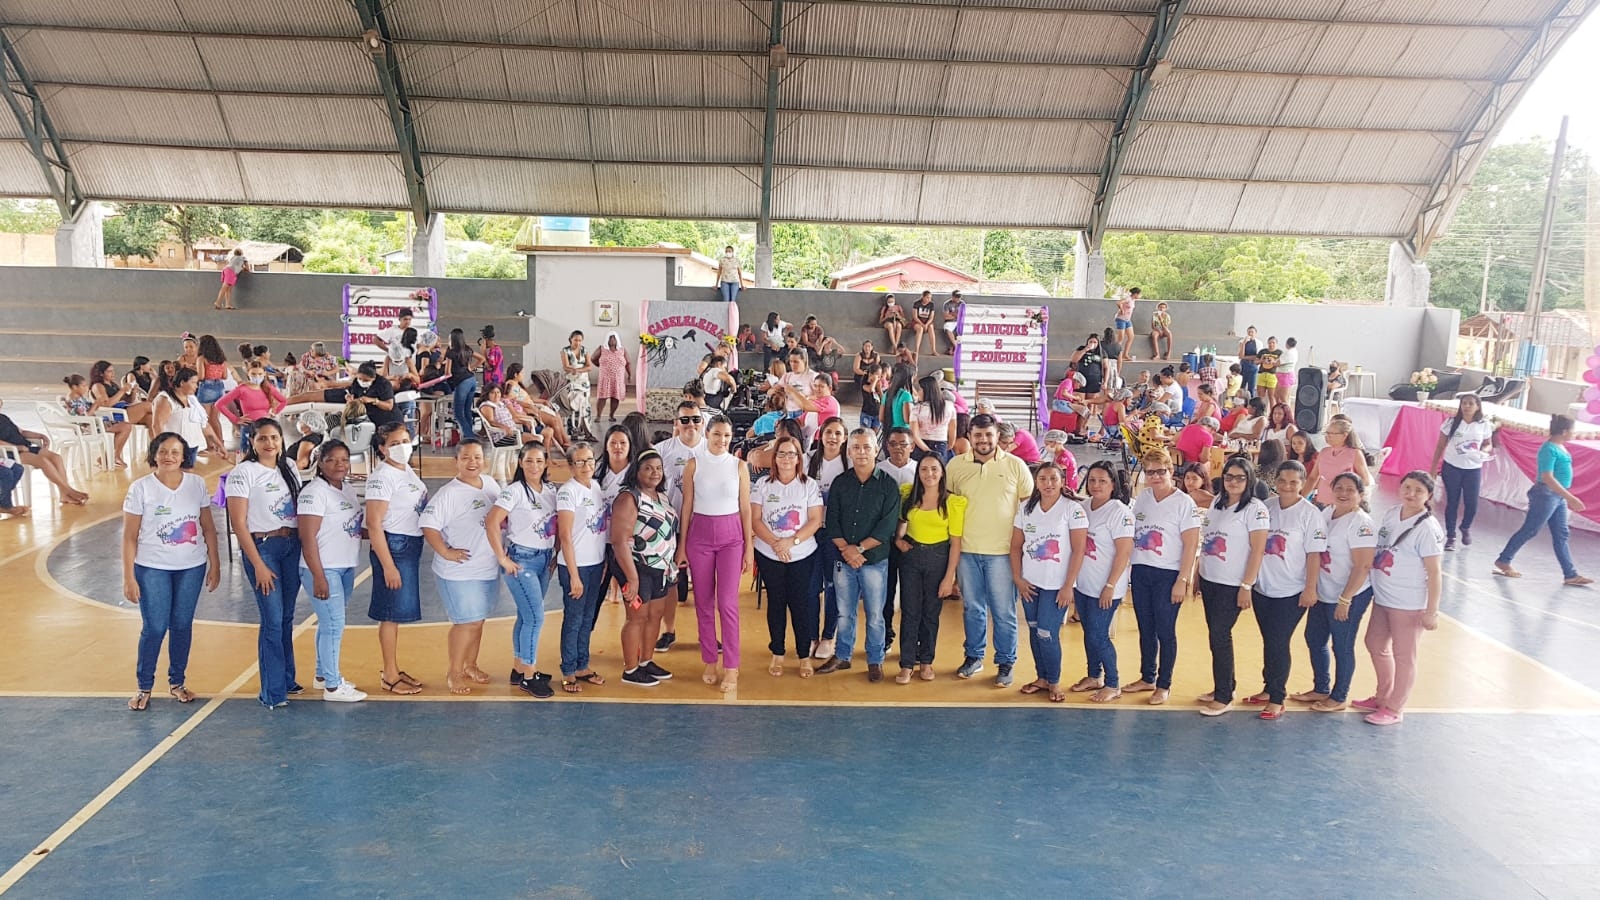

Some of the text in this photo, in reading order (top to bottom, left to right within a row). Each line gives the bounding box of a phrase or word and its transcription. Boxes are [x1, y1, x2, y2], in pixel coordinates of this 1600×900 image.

[972, 323, 1029, 336] MANICURE
[995, 339, 1003, 350] E
[971, 351, 1027, 362] PEDICURE
